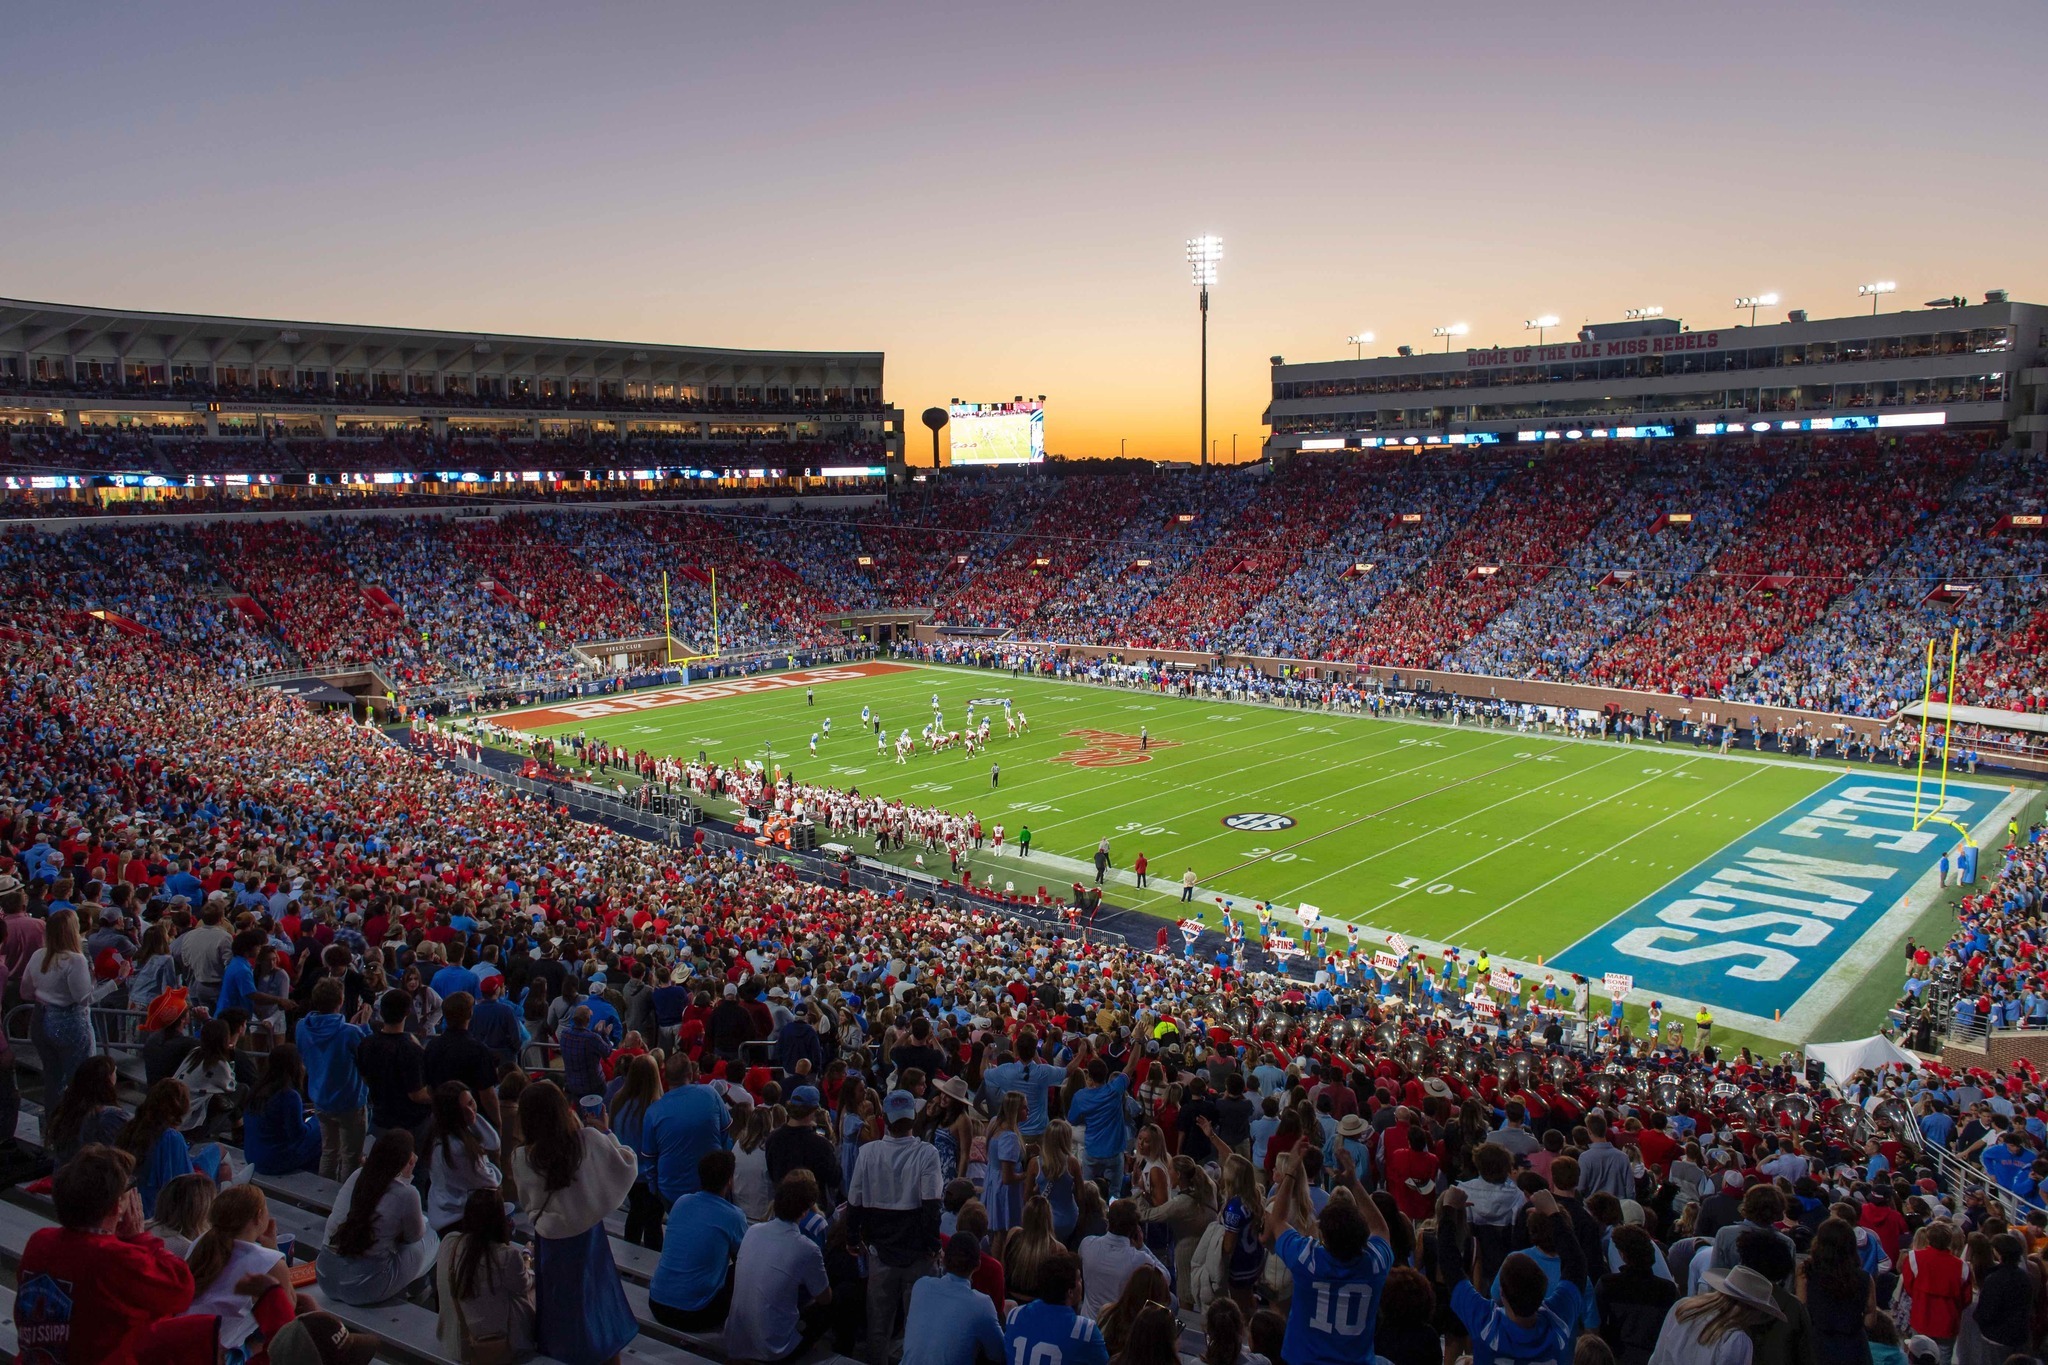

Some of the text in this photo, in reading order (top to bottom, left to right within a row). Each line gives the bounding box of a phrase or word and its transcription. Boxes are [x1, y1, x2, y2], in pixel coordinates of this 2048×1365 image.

[1468, 333, 1719, 367] HOME OF THE OLE MISS REBELS
[805, 414, 821, 422] 74
[829, 414, 842, 422] 10
[605, 643, 642, 653] FIELD CLUB
[549, 669, 867, 719] REBELS
[911, 782, 953, 793] 50
[1007, 801, 1052, 813] 40
[1779, 786, 1976, 854] OLE
[1115, 822, 1166, 836] 30
[777, 832, 785, 840] G
[1240, 847, 1298, 863] 20
[1389, 876, 1455, 895] 10
[1611, 846, 1899, 982] MISS
[1182, 920, 1203, 933] D-FINS
[1270, 939, 1293, 950] D-FINS
[1375, 955, 1398, 968] D-FINS
[1606, 973, 1630, 981] MAKE
[1606, 979, 1630, 987] SOME
[1309, 1281, 1373, 1336] 10
[19, 1324, 71, 1345] ISSISSIPPI
